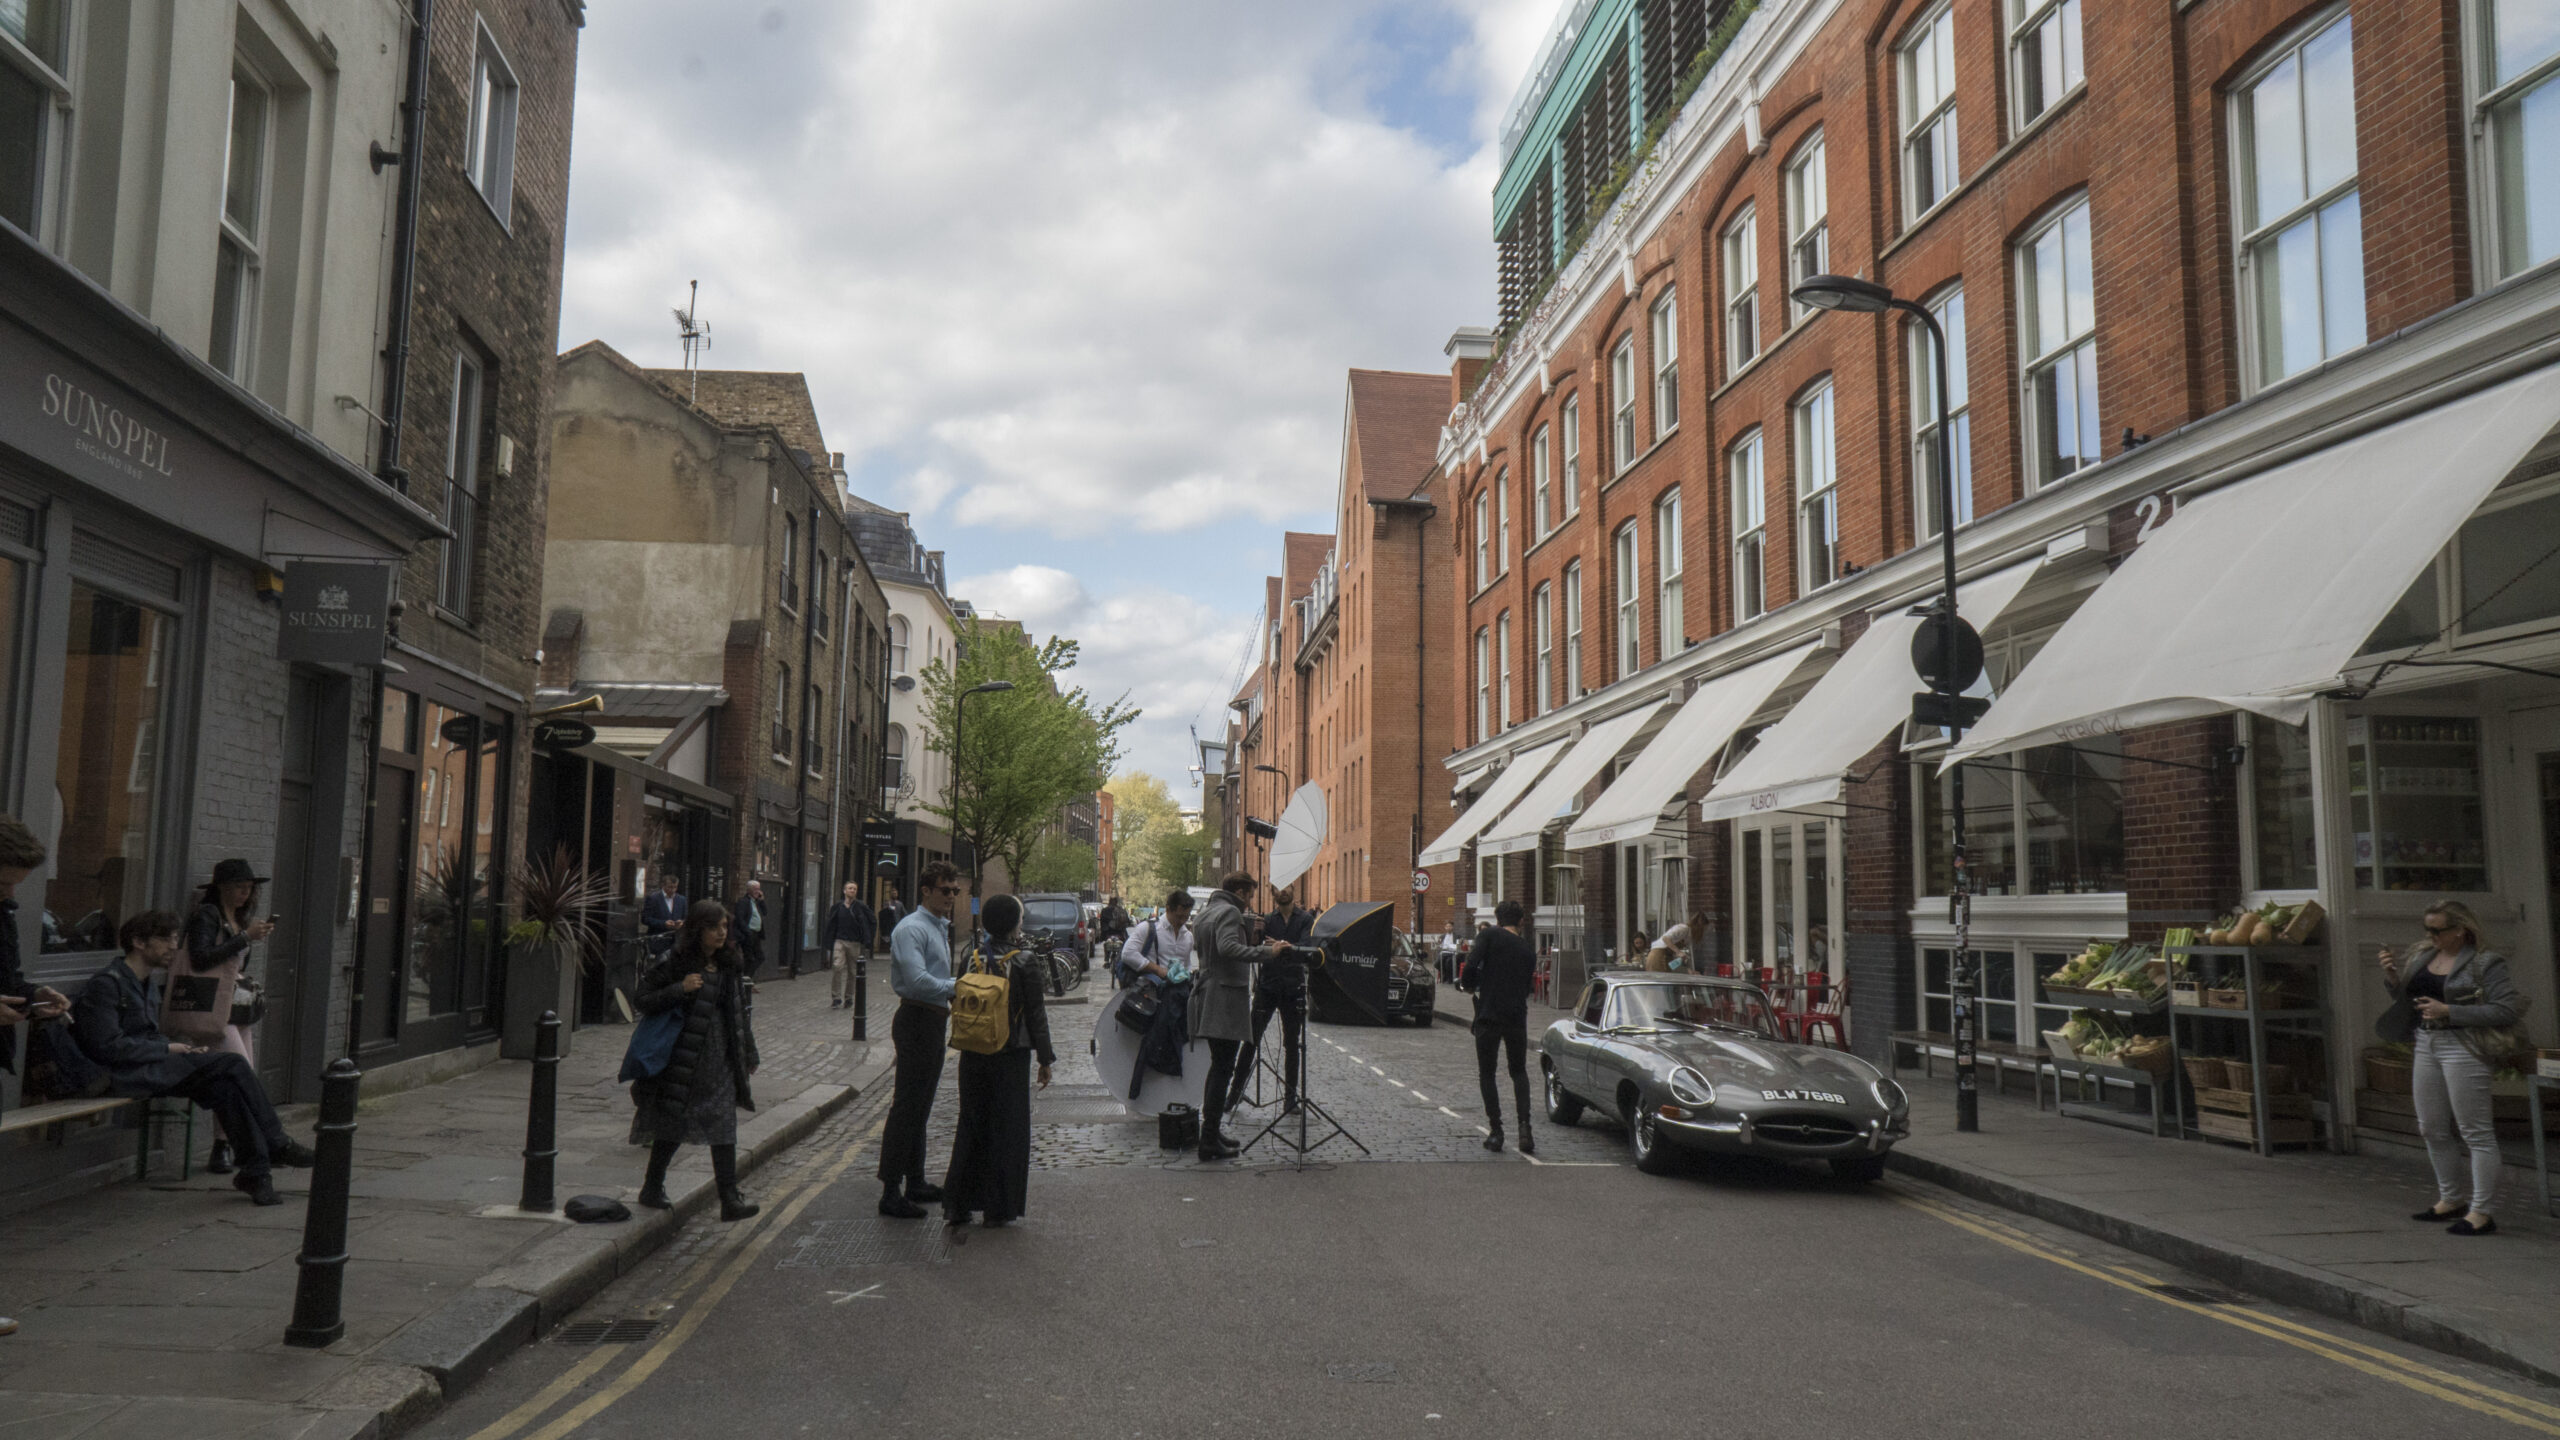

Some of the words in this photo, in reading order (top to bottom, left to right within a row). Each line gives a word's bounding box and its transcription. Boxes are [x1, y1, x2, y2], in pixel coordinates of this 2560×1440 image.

[42, 373, 173, 477] SUNSPEL
[75, 438, 122, 469] ENGLAND
[288, 611, 376, 629] SUNSPEL
[1749, 791, 1779, 811] ALBION
[1414, 877, 1429, 887] 20
[1342, 952, 1379, 965] lumiair
[1761, 1090, 1798, 1100] BLW
[1799, 1090, 1846, 1105] 768B
